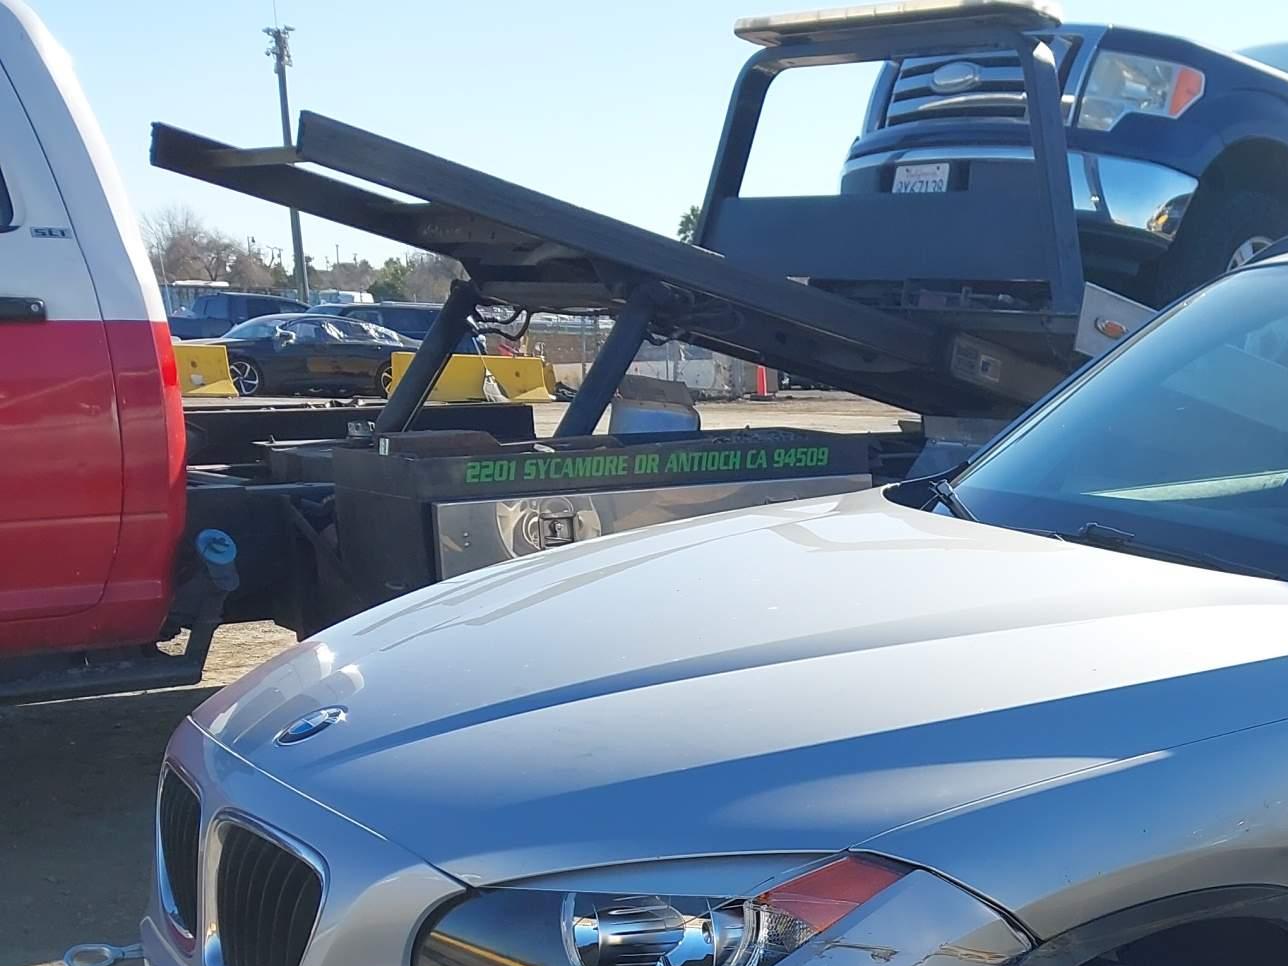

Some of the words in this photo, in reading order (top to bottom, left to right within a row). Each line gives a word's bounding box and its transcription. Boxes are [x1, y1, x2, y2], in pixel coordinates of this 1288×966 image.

[465, 460, 517, 483] 2201
[523, 455, 629, 480] SYCAMORE
[665, 450, 741, 473] ANTIOCH
[746, 449, 768, 470] CA
[773, 447, 829, 468] 94509
